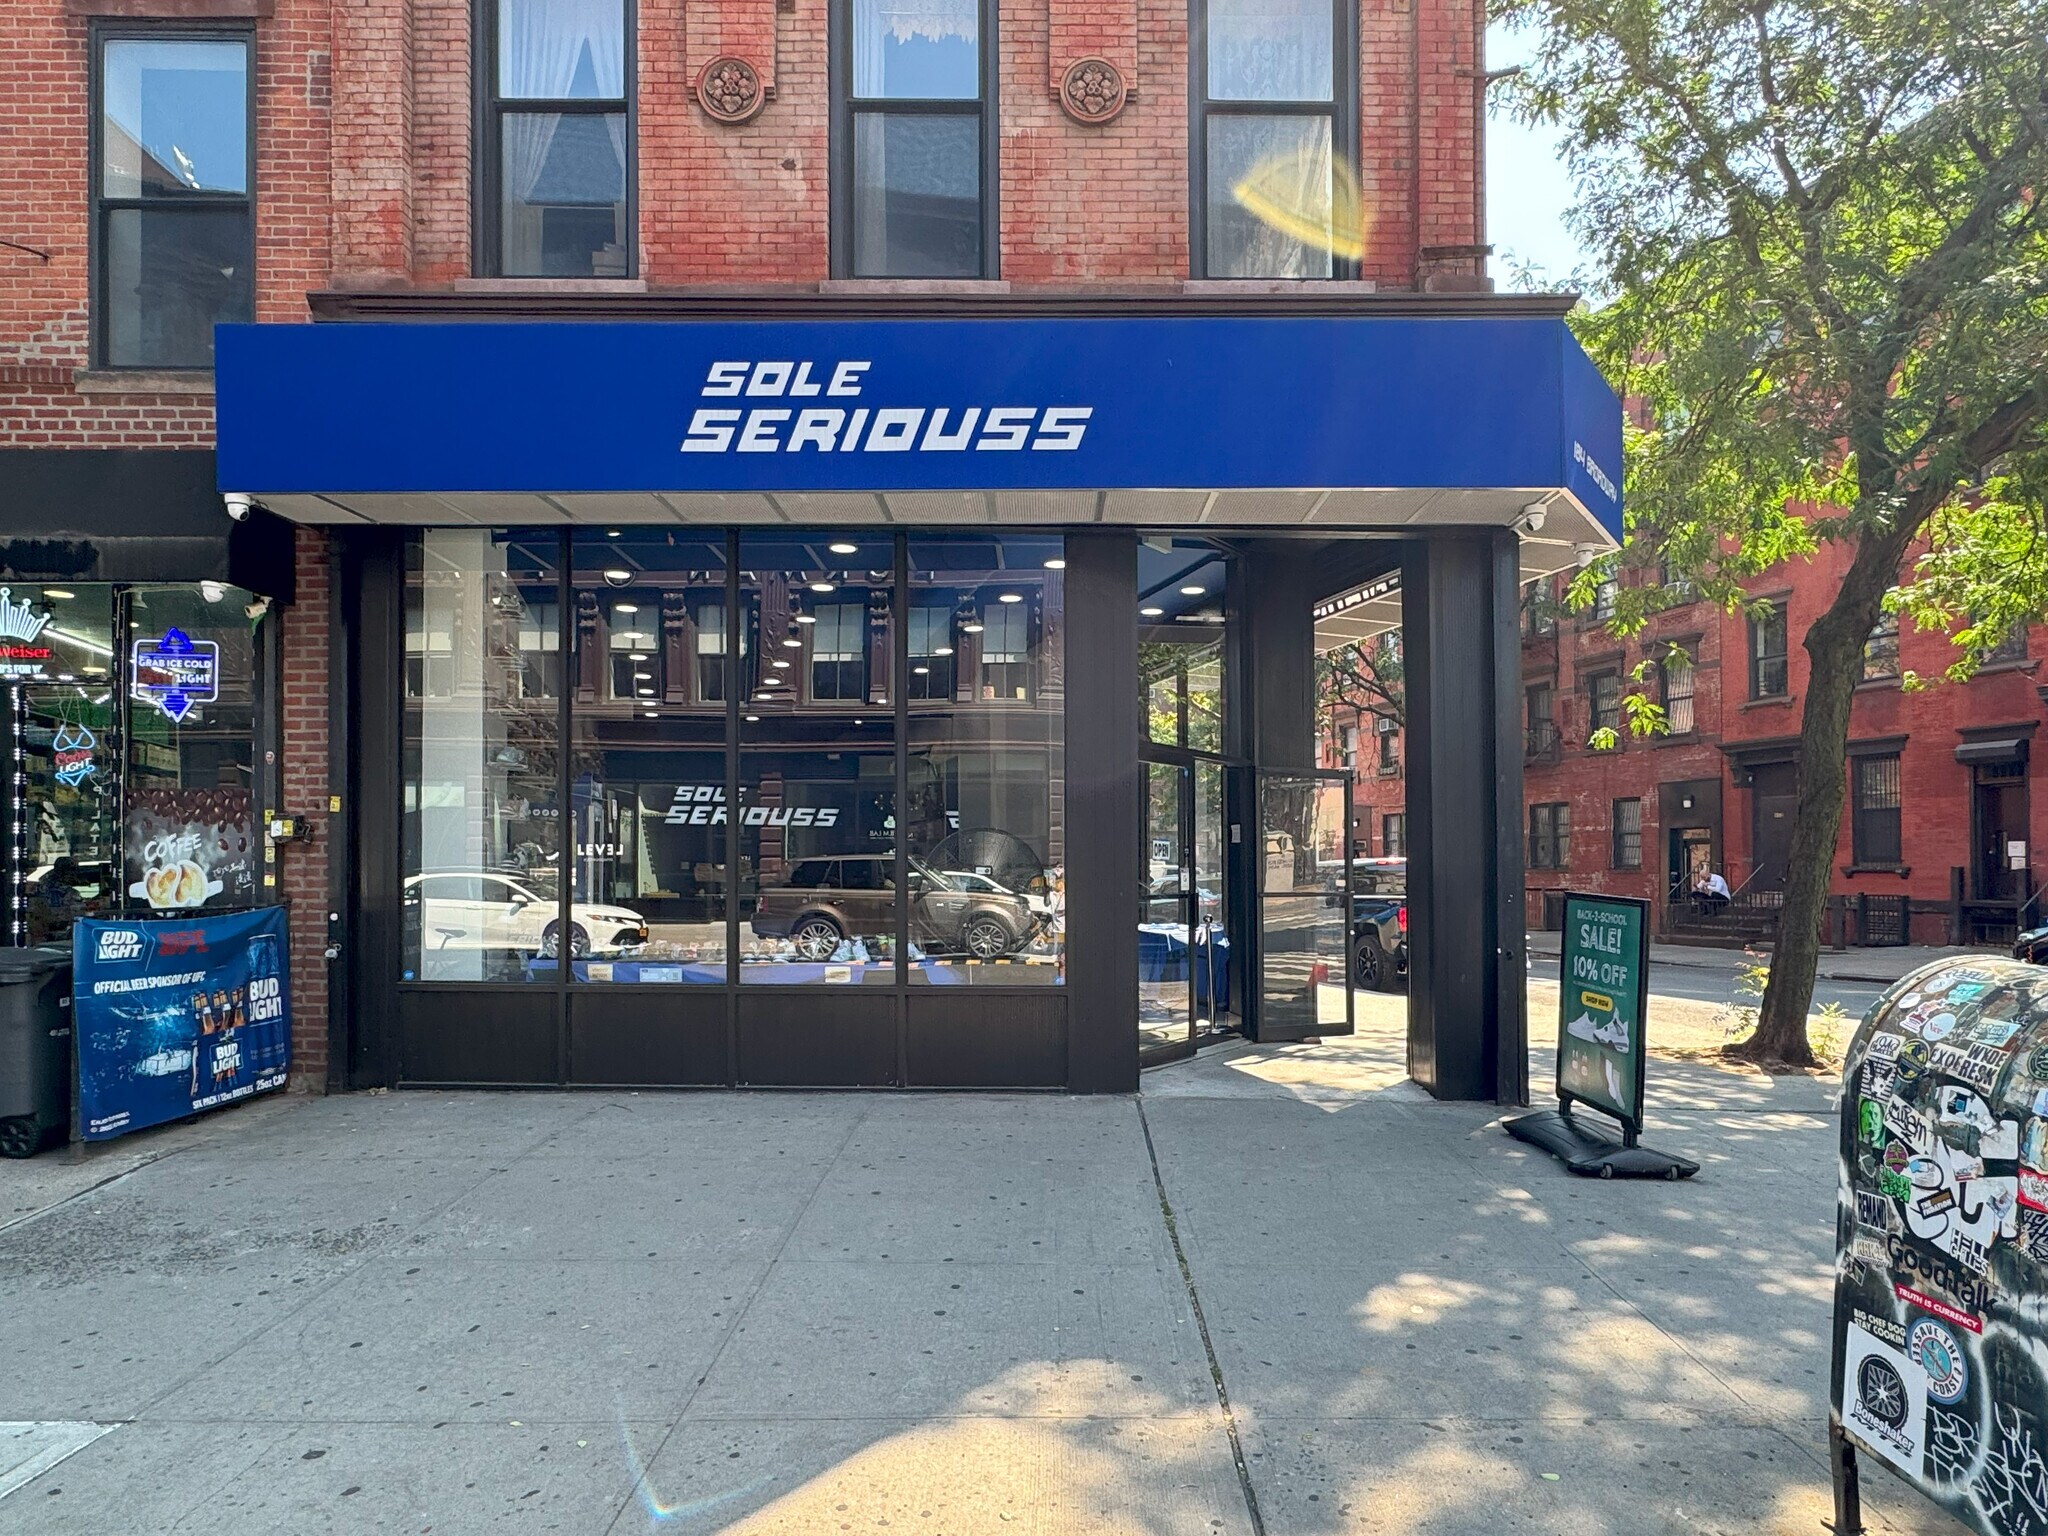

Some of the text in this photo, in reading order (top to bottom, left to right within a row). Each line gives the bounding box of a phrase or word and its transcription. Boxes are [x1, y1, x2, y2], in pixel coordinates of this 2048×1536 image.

[701, 361, 872, 397] SOLE
[680, 407, 1094, 453] SERIOUSS
[138, 658, 212, 669] GRAB ICE COLD
[60, 757, 93, 774] LIGHT
[144, 833, 202, 862] COFFEE
[1154, 842, 1170, 858] OPEN
[1577, 908, 1628, 926] BACK-2-SCHOOL
[101, 931, 139, 945] BUD
[1580, 923, 1622, 955] SALE!
[1573, 954, 1628, 987] 10% OFF
[94, 979, 132, 995] OFFICIAL
[148, 974, 182, 989] SPONSOR
[249, 977, 280, 1002] BUD
[215, 1042, 239, 1060] BUD
[212, 1053, 241, 1075] LIGHT
[1898, 1287, 1979, 1330] TRUTH IS CURRENCY
[1853, 1308, 1907, 1337] BIG CHEF DOG
[1854, 1317, 1905, 1345] STAY COOKIN
[1914, 1324, 1938, 1343] SAVE
[1943, 1334, 1961, 1364] THE
[1933, 1373, 1960, 1395] COAST
[1855, 1399, 1915, 1451] Boneshaker
